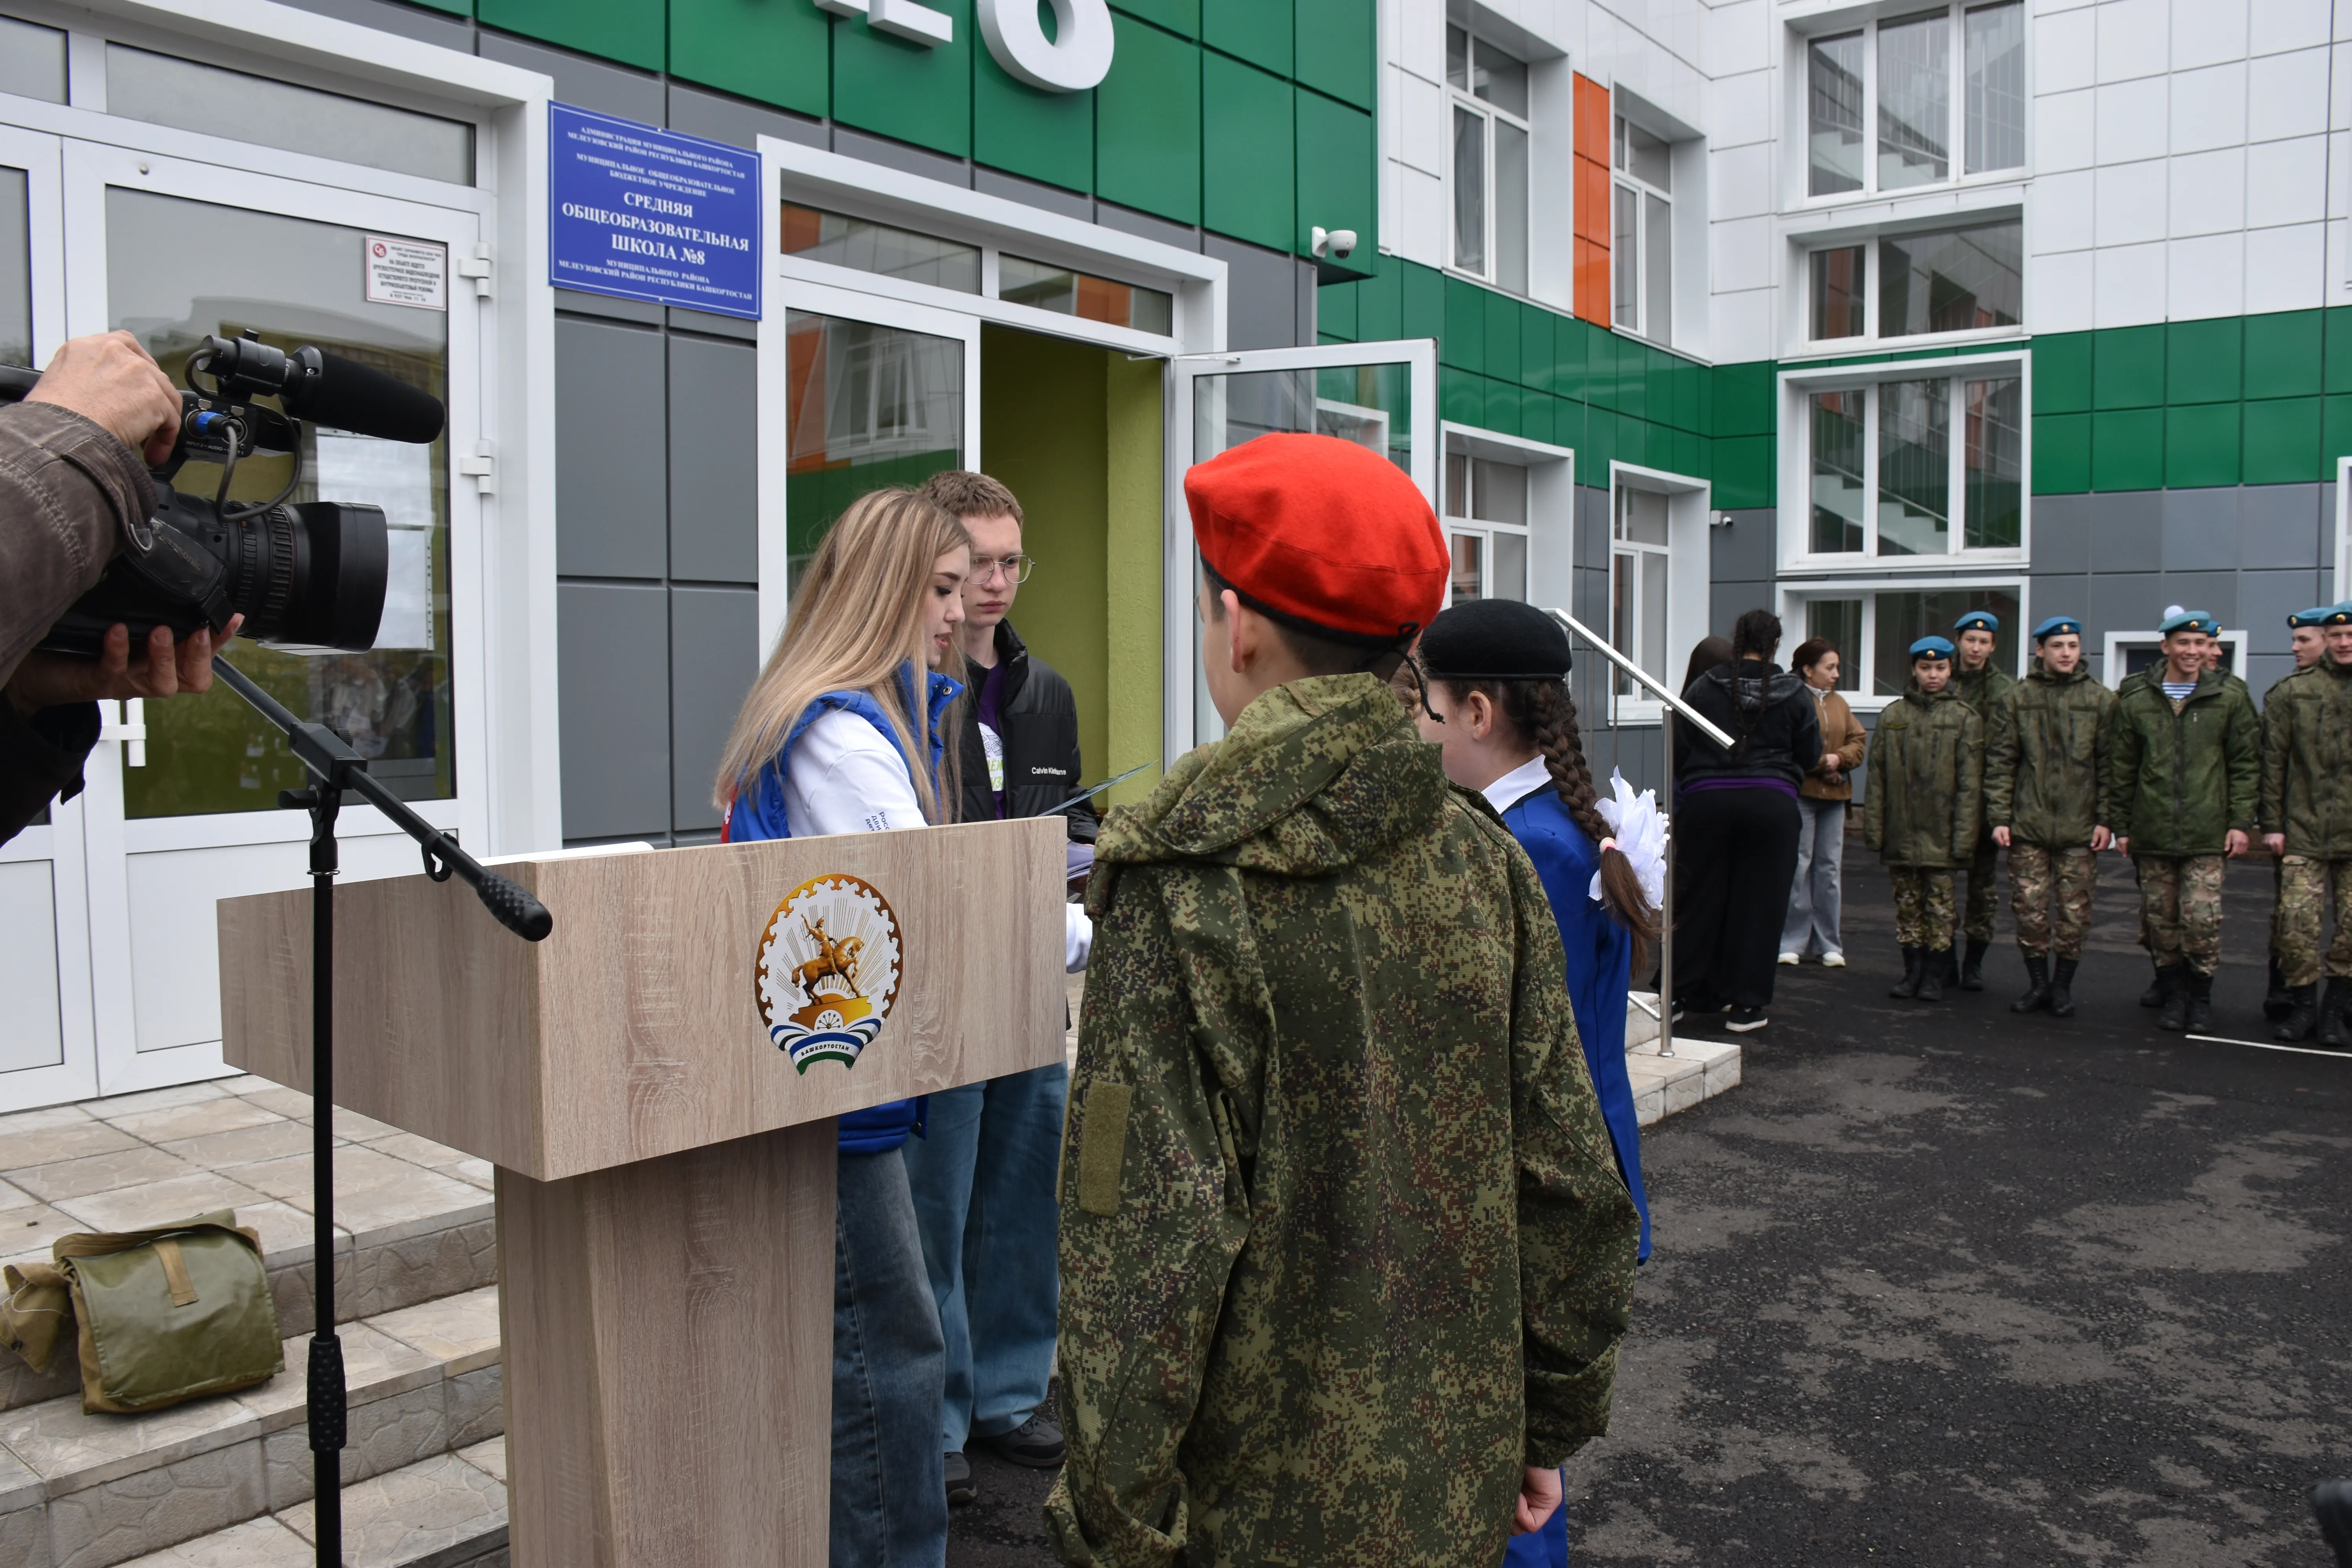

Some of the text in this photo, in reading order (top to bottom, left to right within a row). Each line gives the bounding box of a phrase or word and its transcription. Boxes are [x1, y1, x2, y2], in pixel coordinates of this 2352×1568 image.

[568, 131, 745, 179] МЕЛЕУЗОВСКИЙ РАЙОН РЕСПУБЛИКИ БАШКОРТОСТАН
[581, 127, 733, 168] АДМИНИСТРАЦИЯ МУНИЦИПАЛЬНОГО РАЙОНА
[576, 152, 735, 195] МУНИЦИПАЛЬНОЕ ОБЩЕОБРАЗОВАТЕЛЬНОЕ
[610, 170, 707, 197] БЮДЖЕТНОЕ УЧРЕЖДЕНИЕ
[624, 192, 693, 218] СРЕДНЯЯ
[562, 202, 749, 252] ОБЩЕОБРАЗОВАТЕЛЬНАЯ
[612, 234, 706, 265] ШКОЛА №8
[559, 259, 752, 300] МЕЛЕУЗОВСКИЙ РАЙОН РЕСПУБЛИКИ БАШКОРТОСТАН
[606, 259, 710, 284] МУНИЦИПАЛЬНОГО РАЙОНА
[801, 1044, 849, 1056] БАШКОРТОСТАН
